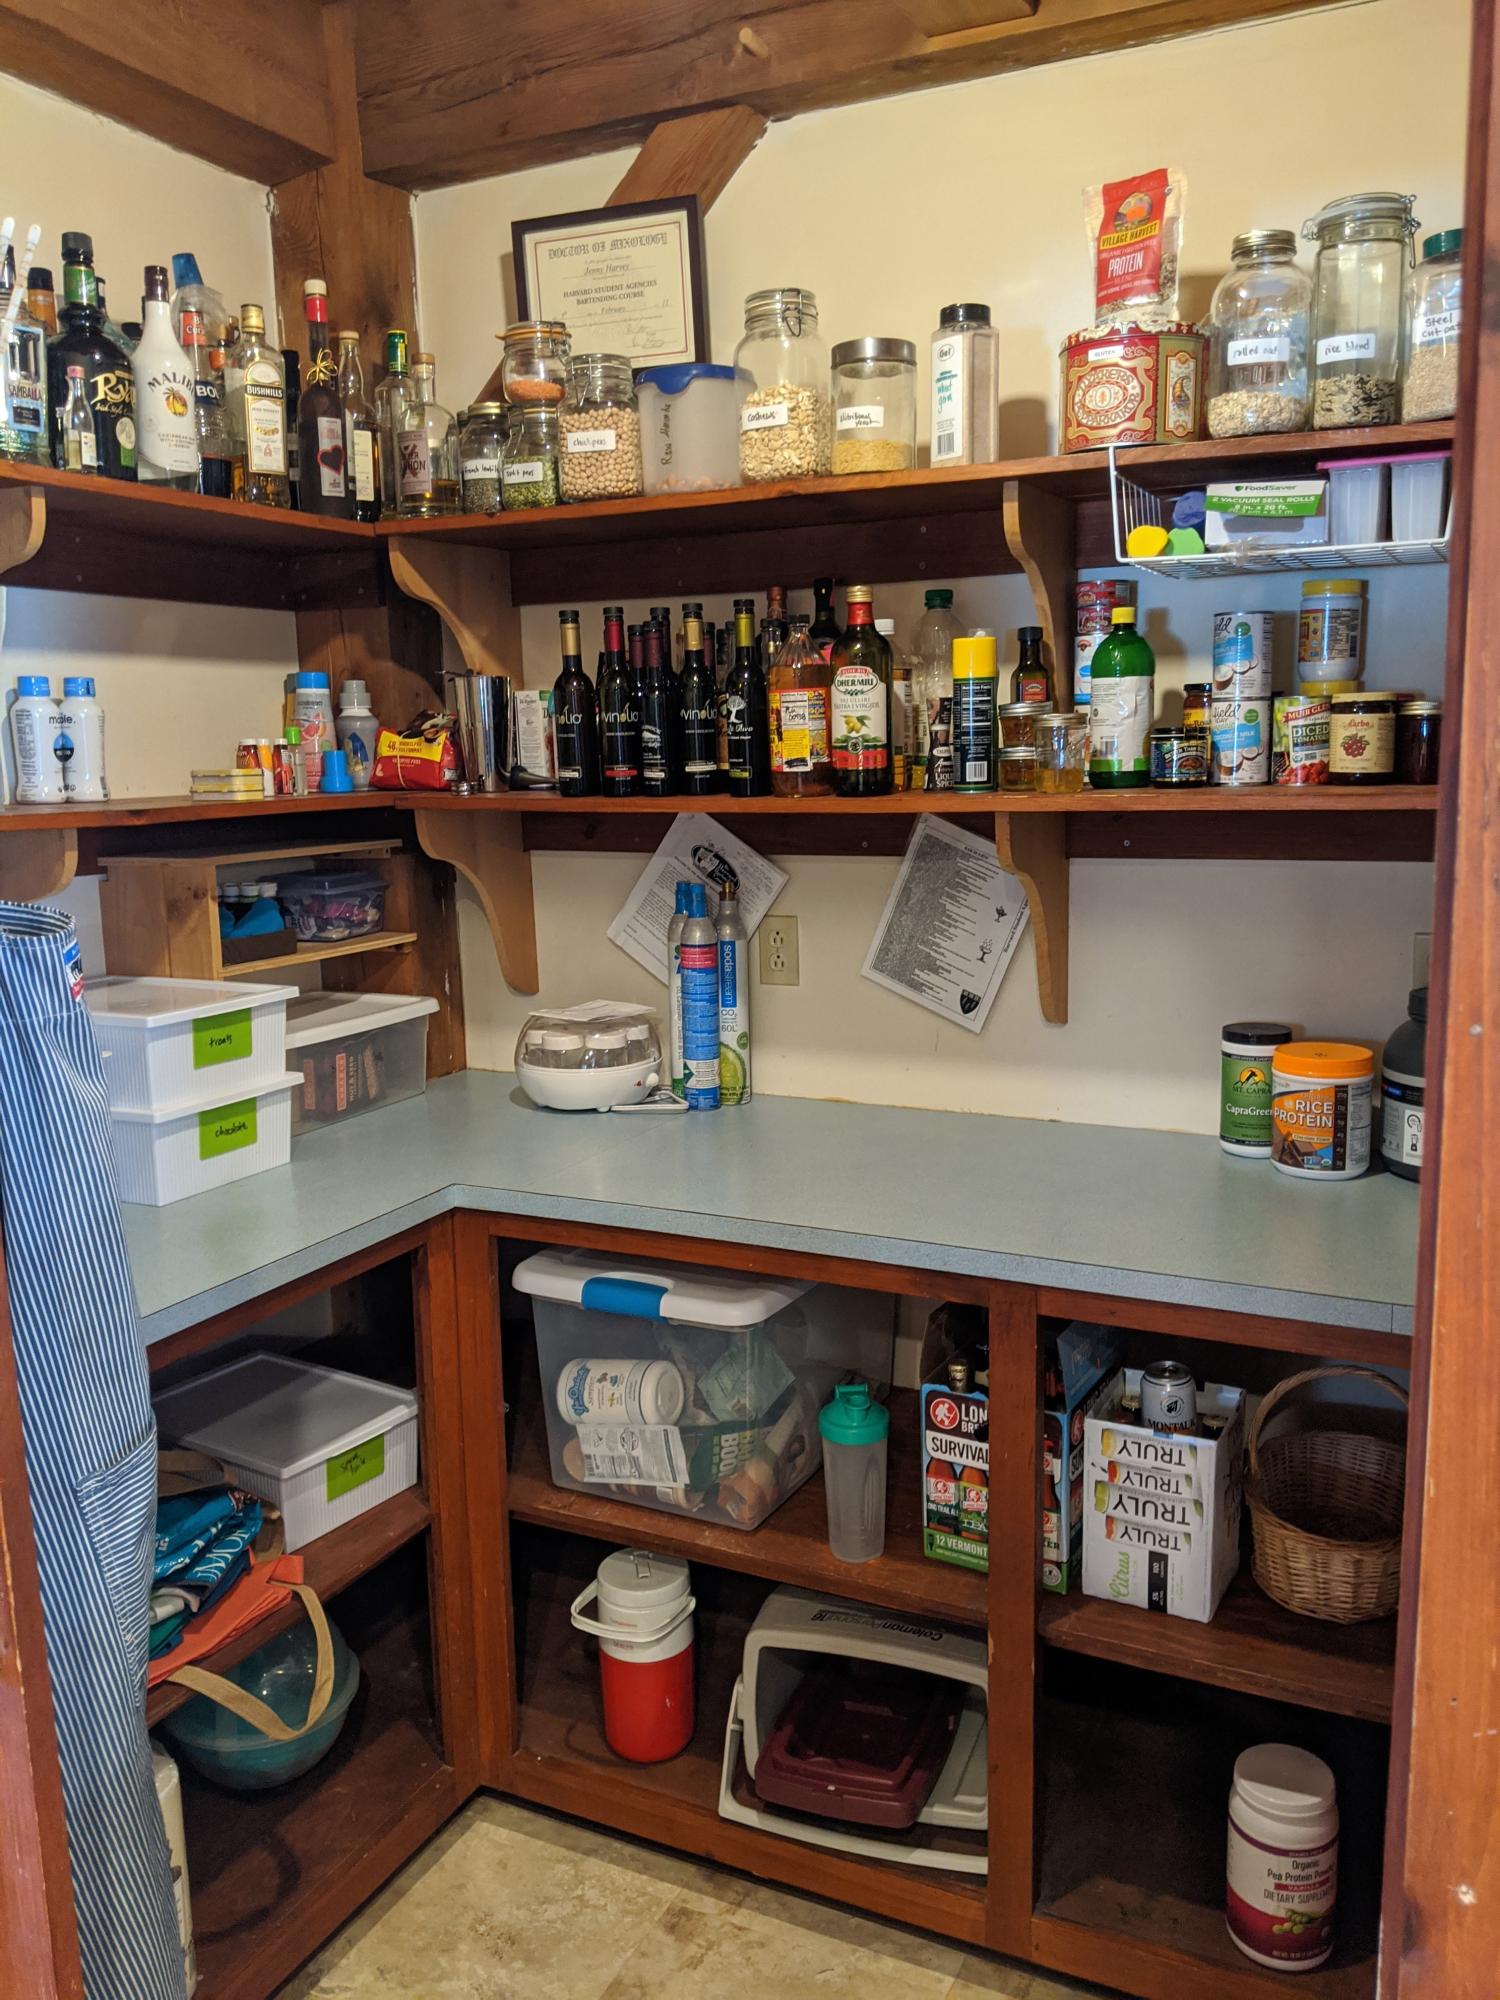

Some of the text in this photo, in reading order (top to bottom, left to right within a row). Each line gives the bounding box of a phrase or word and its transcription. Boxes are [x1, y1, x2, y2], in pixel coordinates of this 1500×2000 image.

[1102, 223, 1158, 247] VILLAGE HARVEST
[1108, 250, 1144, 279] PROTEIN
[563, 279, 657, 298] HARVARD STUDENT AGENCIES
[576, 290, 644, 306] BARTENDING COURSE
[1425, 312, 1453, 328] Steel
[1325, 344, 1341, 355] rice
[246, 384, 283, 400] BUSHMILLS
[1245, 484, 1297, 492] FoodSaver
[1220, 496, 1260, 504] VACUUM
[1287, 495, 1315, 503] ROLLS
[1288, 709, 1311, 720] MUIR
[1292, 724, 1329, 737] DICED
[935, 772, 953, 781] LIQU
[936, 780, 953, 788] SPIC
[723, 944, 734, 1005] sodastream
[209, 1034, 232, 1048] treats
[1246, 1086, 1272, 1094] CAPRA
[1295, 1099, 1333, 1114] RICE
[1274, 1107, 1333, 1128] PROTEIN
[961, 1402, 988, 1422] LON
[1118, 1439, 1187, 1467] TRULY
[1122, 1471, 1183, 1495] TRULY
[1112, 1494, 1190, 1526] TRULY
[935, 1534, 945, 1546] 12
[946, 1537, 988, 1558] VERMONT
[1119, 1525, 1182, 1551] TRULY
[1109, 1551, 1130, 1598] Citrus
[811, 1611, 826, 1622] 16
[882, 1620, 944, 1642] Coleman
[1291, 1859, 1319, 1870] Organic
[1267, 1868, 1283, 1880] Pea
[1285, 1869, 1313, 1883] Protein
[1264, 1888, 1295, 1905] DIETARY
